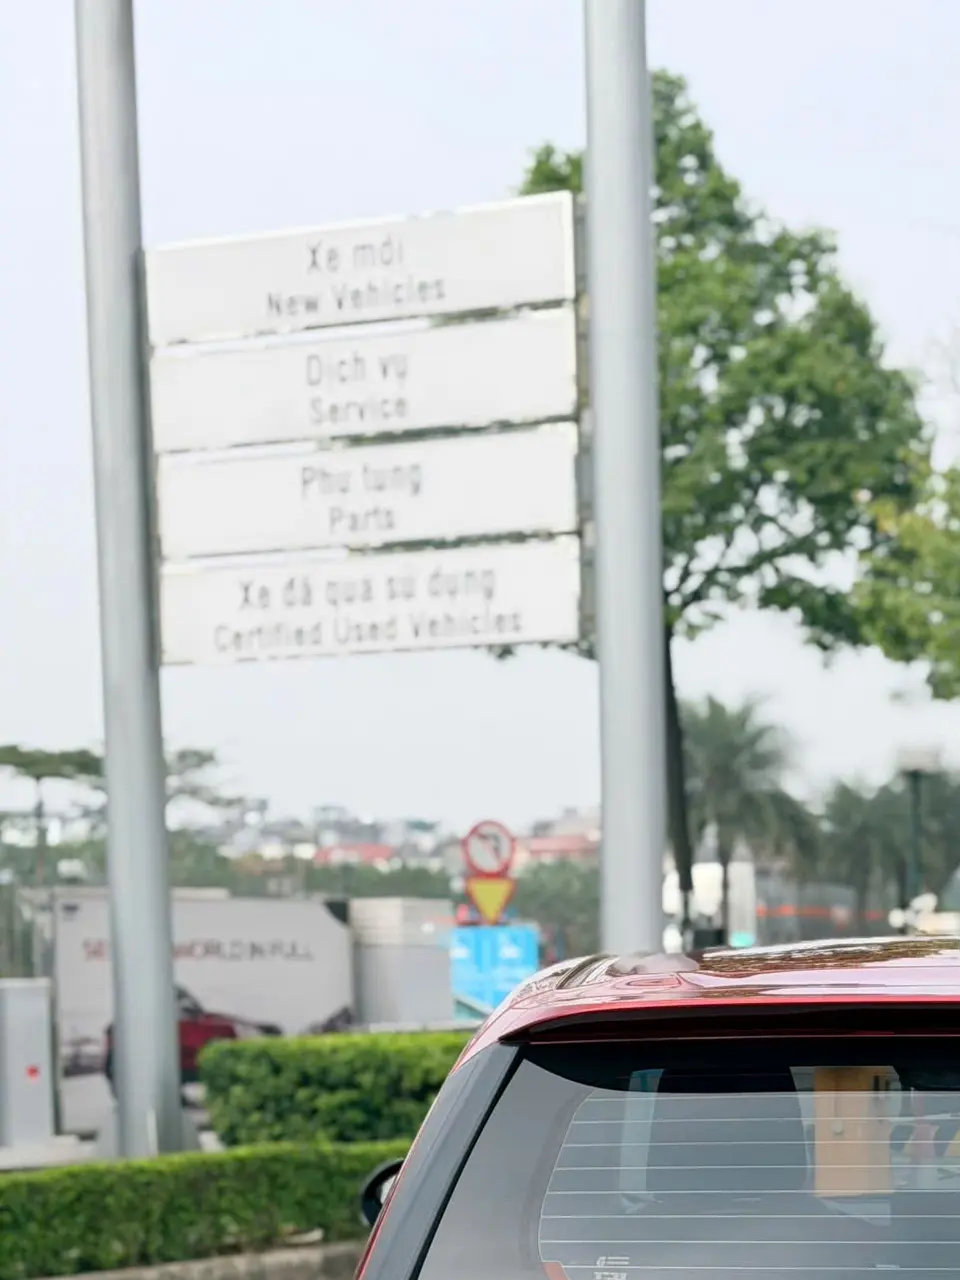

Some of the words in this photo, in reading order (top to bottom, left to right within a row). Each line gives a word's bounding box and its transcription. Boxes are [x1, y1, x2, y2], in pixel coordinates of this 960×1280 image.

[306, 239, 340, 275] Xe
[266, 290, 320, 318] New
[333, 275, 446, 311] Vehicles
[309, 396, 408, 427] Service
[328, 505, 396, 535] Parts
[239, 580, 271, 611] Xe
[213, 620, 323, 653] Certified
[333, 613, 399, 645] Used
[409, 607, 524, 639] Vehicles
